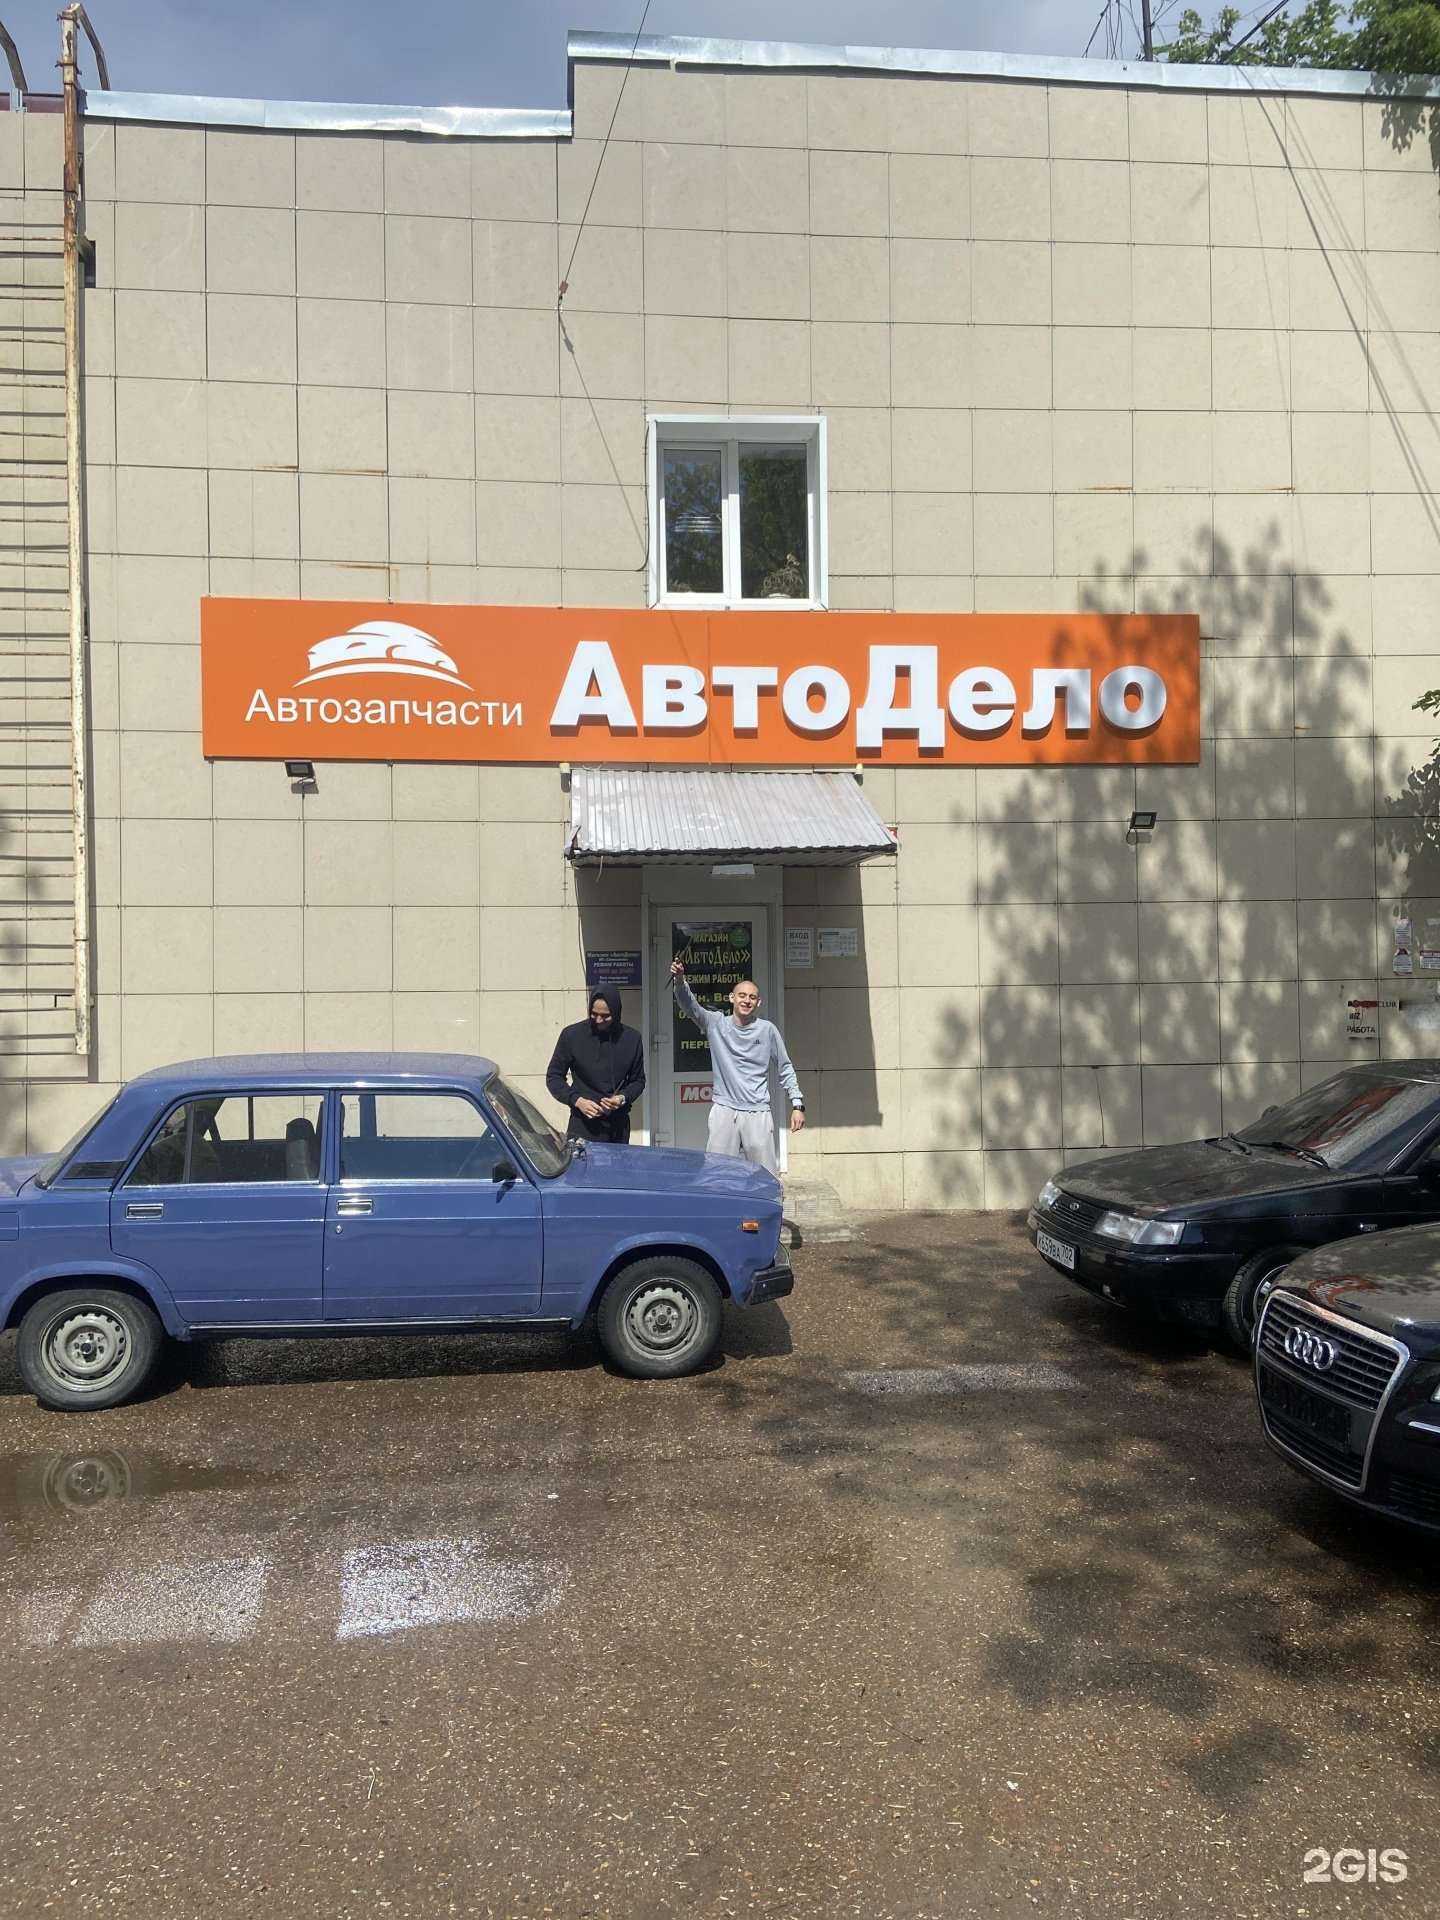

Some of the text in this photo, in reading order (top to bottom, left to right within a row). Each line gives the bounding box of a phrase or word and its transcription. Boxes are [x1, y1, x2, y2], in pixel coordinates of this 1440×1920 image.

[245, 688, 523, 726] Автозапчасти
[549, 640, 1167, 752] АвтоДело
[681, 1040, 712, 1050] ПЕРЕ
